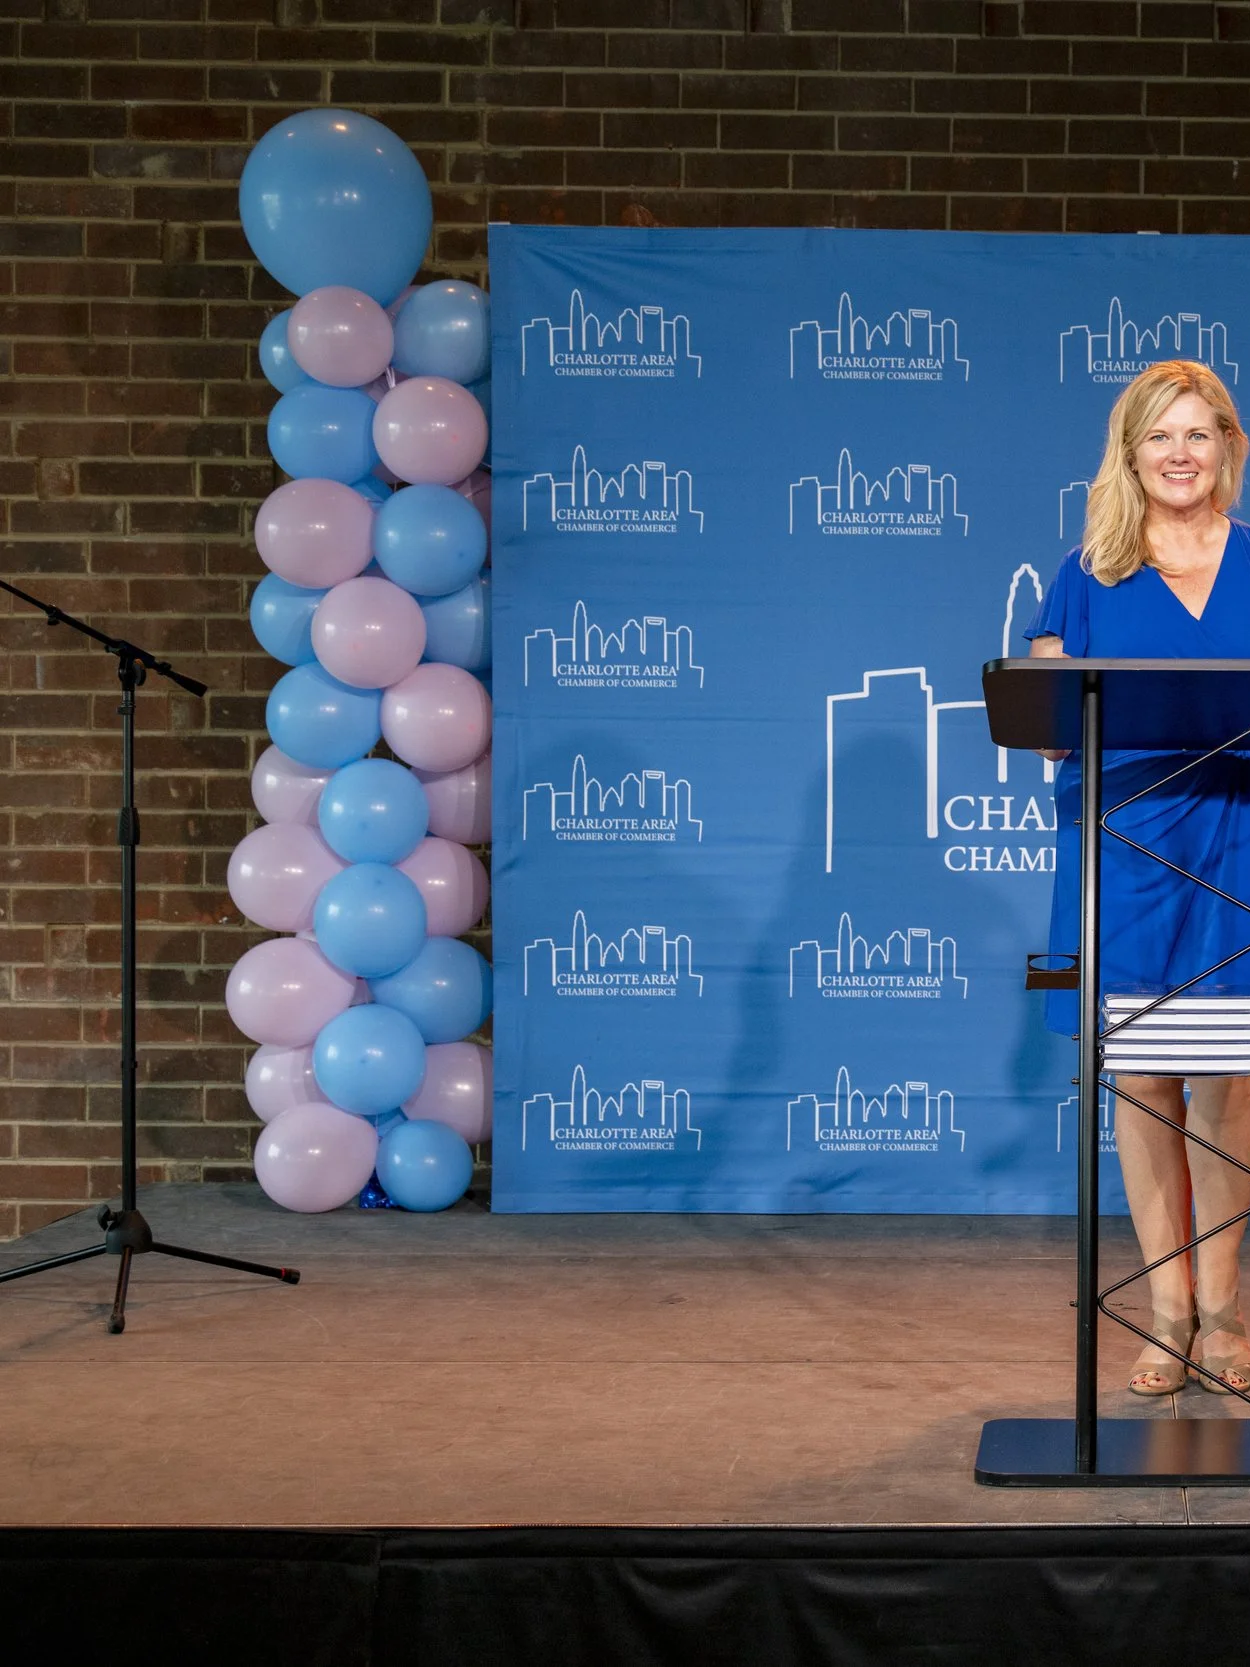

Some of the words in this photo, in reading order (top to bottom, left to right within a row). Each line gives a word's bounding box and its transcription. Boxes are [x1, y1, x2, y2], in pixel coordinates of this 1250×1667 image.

[554, 353, 638, 366] CHARLOTTE
[639, 353, 674, 366] AREA
[823, 356, 906, 369] CHARLOTTE
[908, 356, 943, 369] AREA
[554, 367, 603, 377] CHAMBER
[603, 367, 617, 377] OF
[618, 367, 675, 377] COMMERCE
[1092, 360, 1153, 372] CHARLO
[822, 370, 871, 381] CHAMBER
[871, 370, 885, 381] OF
[886, 370, 943, 381] COMMERCE
[1092, 374, 1136, 383] CHAMBE
[556, 508, 640, 521] CHARLOTTE
[642, 508, 678, 521] AREA
[822, 512, 905, 525] CHARLOTTE
[906, 512, 942, 525] AREA
[556, 523, 605, 533] CHAMBER
[605, 523, 619, 533] OF
[620, 523, 677, 533] COMMERCE
[822, 526, 870, 536] CHAMBER
[870, 526, 885, 536] OF
[885, 526, 942, 536] COMMERCE
[557, 664, 641, 677] CHARLOTTE
[642, 664, 677, 677] AREA
[557, 678, 605, 688] CHAMBER
[606, 678, 620, 688] OF
[620, 678, 677, 688] COMMERCE
[556, 818, 639, 830] CHARLOTTE
[641, 818, 676, 830] AREA
[555, 832, 604, 841] CHAMBER
[604, 832, 618, 841] OF
[619, 832, 676, 841] COMMERCE
[943, 845, 1057, 872] CHAM
[557, 973, 640, 985] CHARLOTTE
[641, 973, 677, 985] AREA
[822, 975, 905, 988] CHARLOTTE
[906, 975, 941, 988] AREA
[556, 987, 605, 997] CHAMBER
[605, 987, 620, 997] OF
[620, 987, 677, 997] COMMERCE
[822, 989, 870, 999] CHAMBER
[870, 989, 884, 999] OF
[884, 989, 941, 999] COMMERCE
[554, 1127, 638, 1139] CHARLOTTE
[639, 1127, 675, 1139] AREA
[819, 1128, 902, 1141] CHARLOTTE
[903, 1128, 938, 1141] AREA
[554, 1141, 603, 1151] CHAMBER
[603, 1141, 618, 1151] OF
[618, 1141, 674, 1151] COMMERCE
[819, 1142, 867, 1152] CHAMBER
[867, 1142, 882, 1152] OF
[882, 1142, 938, 1152] COMMERCE
